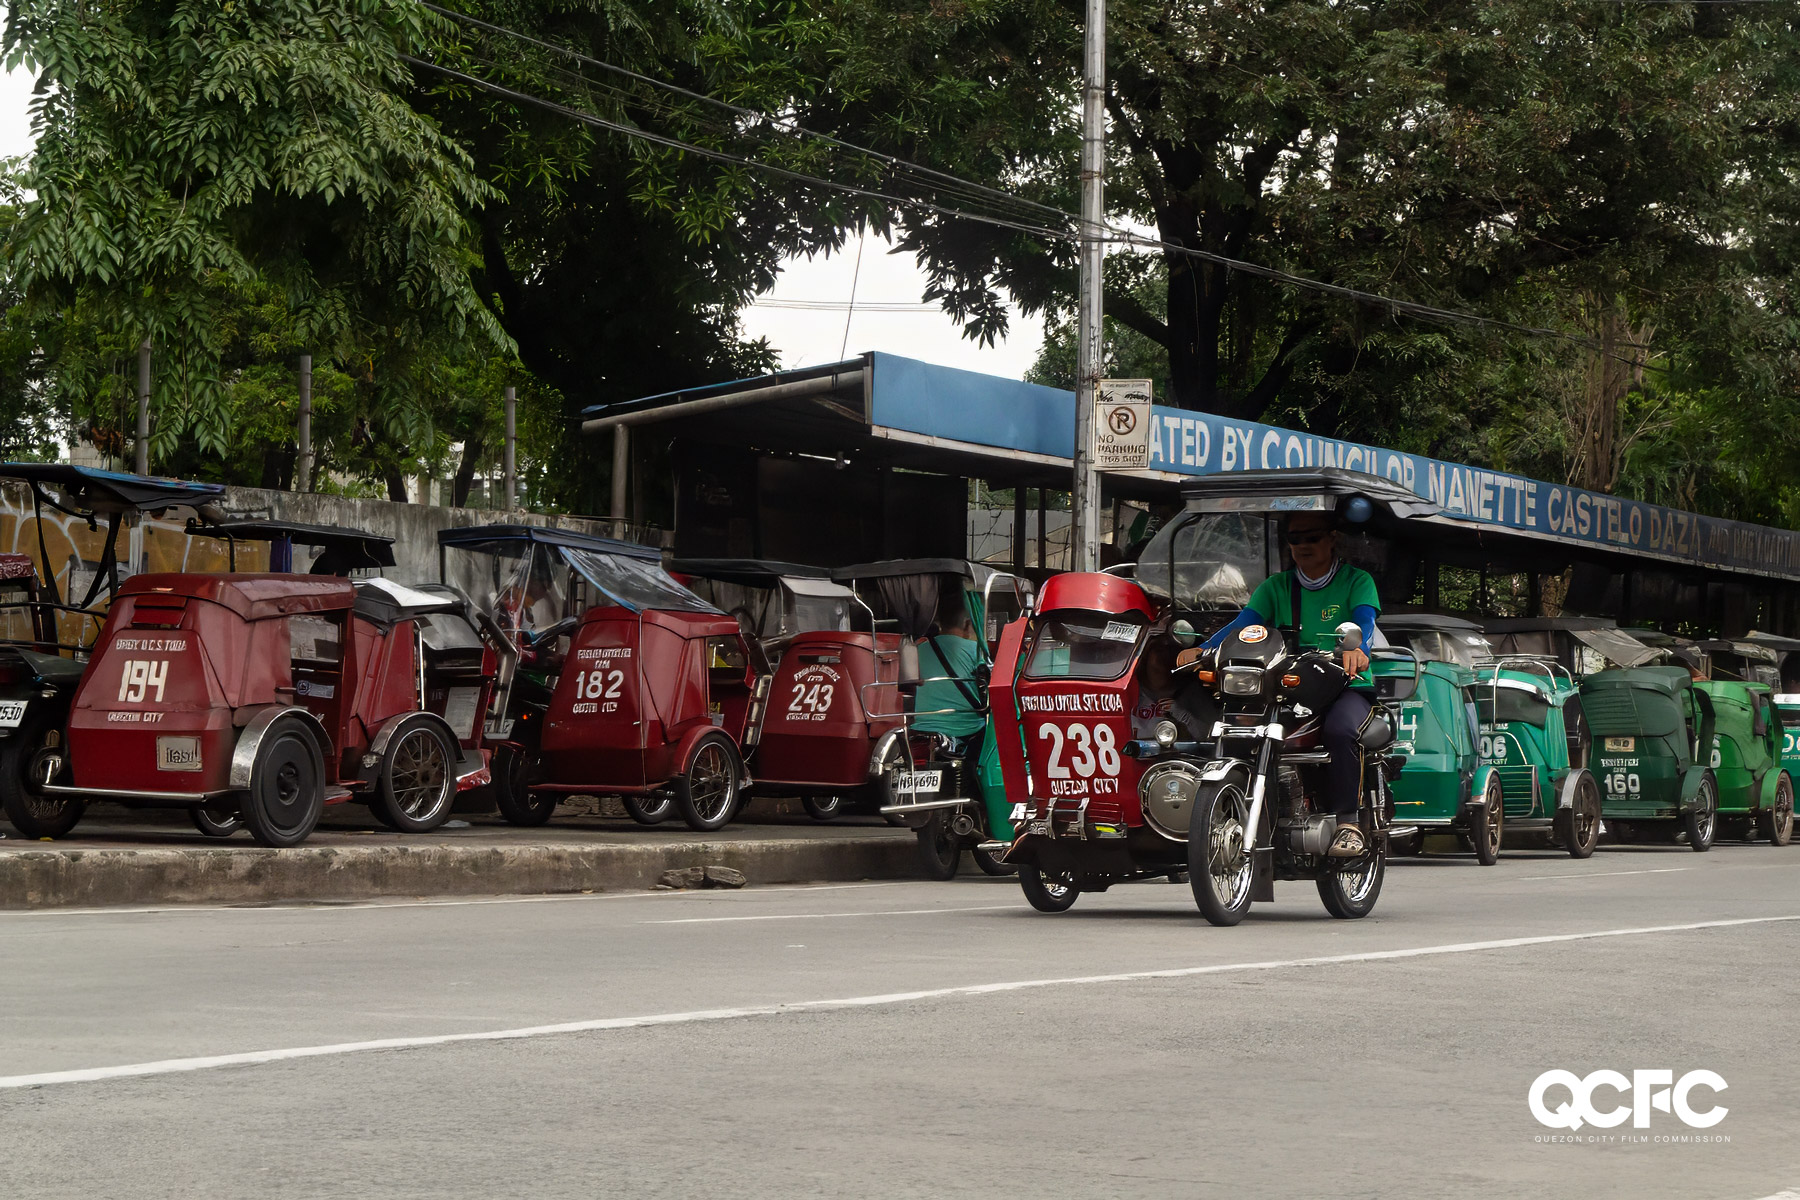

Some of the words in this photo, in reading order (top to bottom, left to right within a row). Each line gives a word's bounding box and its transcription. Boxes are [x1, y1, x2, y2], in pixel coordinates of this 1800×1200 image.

[1099, 435, 1114, 443] NO
[1221, 425, 1254, 471] BY
[1428, 462, 1537, 526] NANETTE
[1650, 507, 1701, 557] DAZA
[118, 660, 169, 703] 194
[576, 669, 624, 699] 182
[788, 683, 834, 712] 243
[1039, 723, 1121, 778] 238
[1604, 773, 1641, 794] 160
